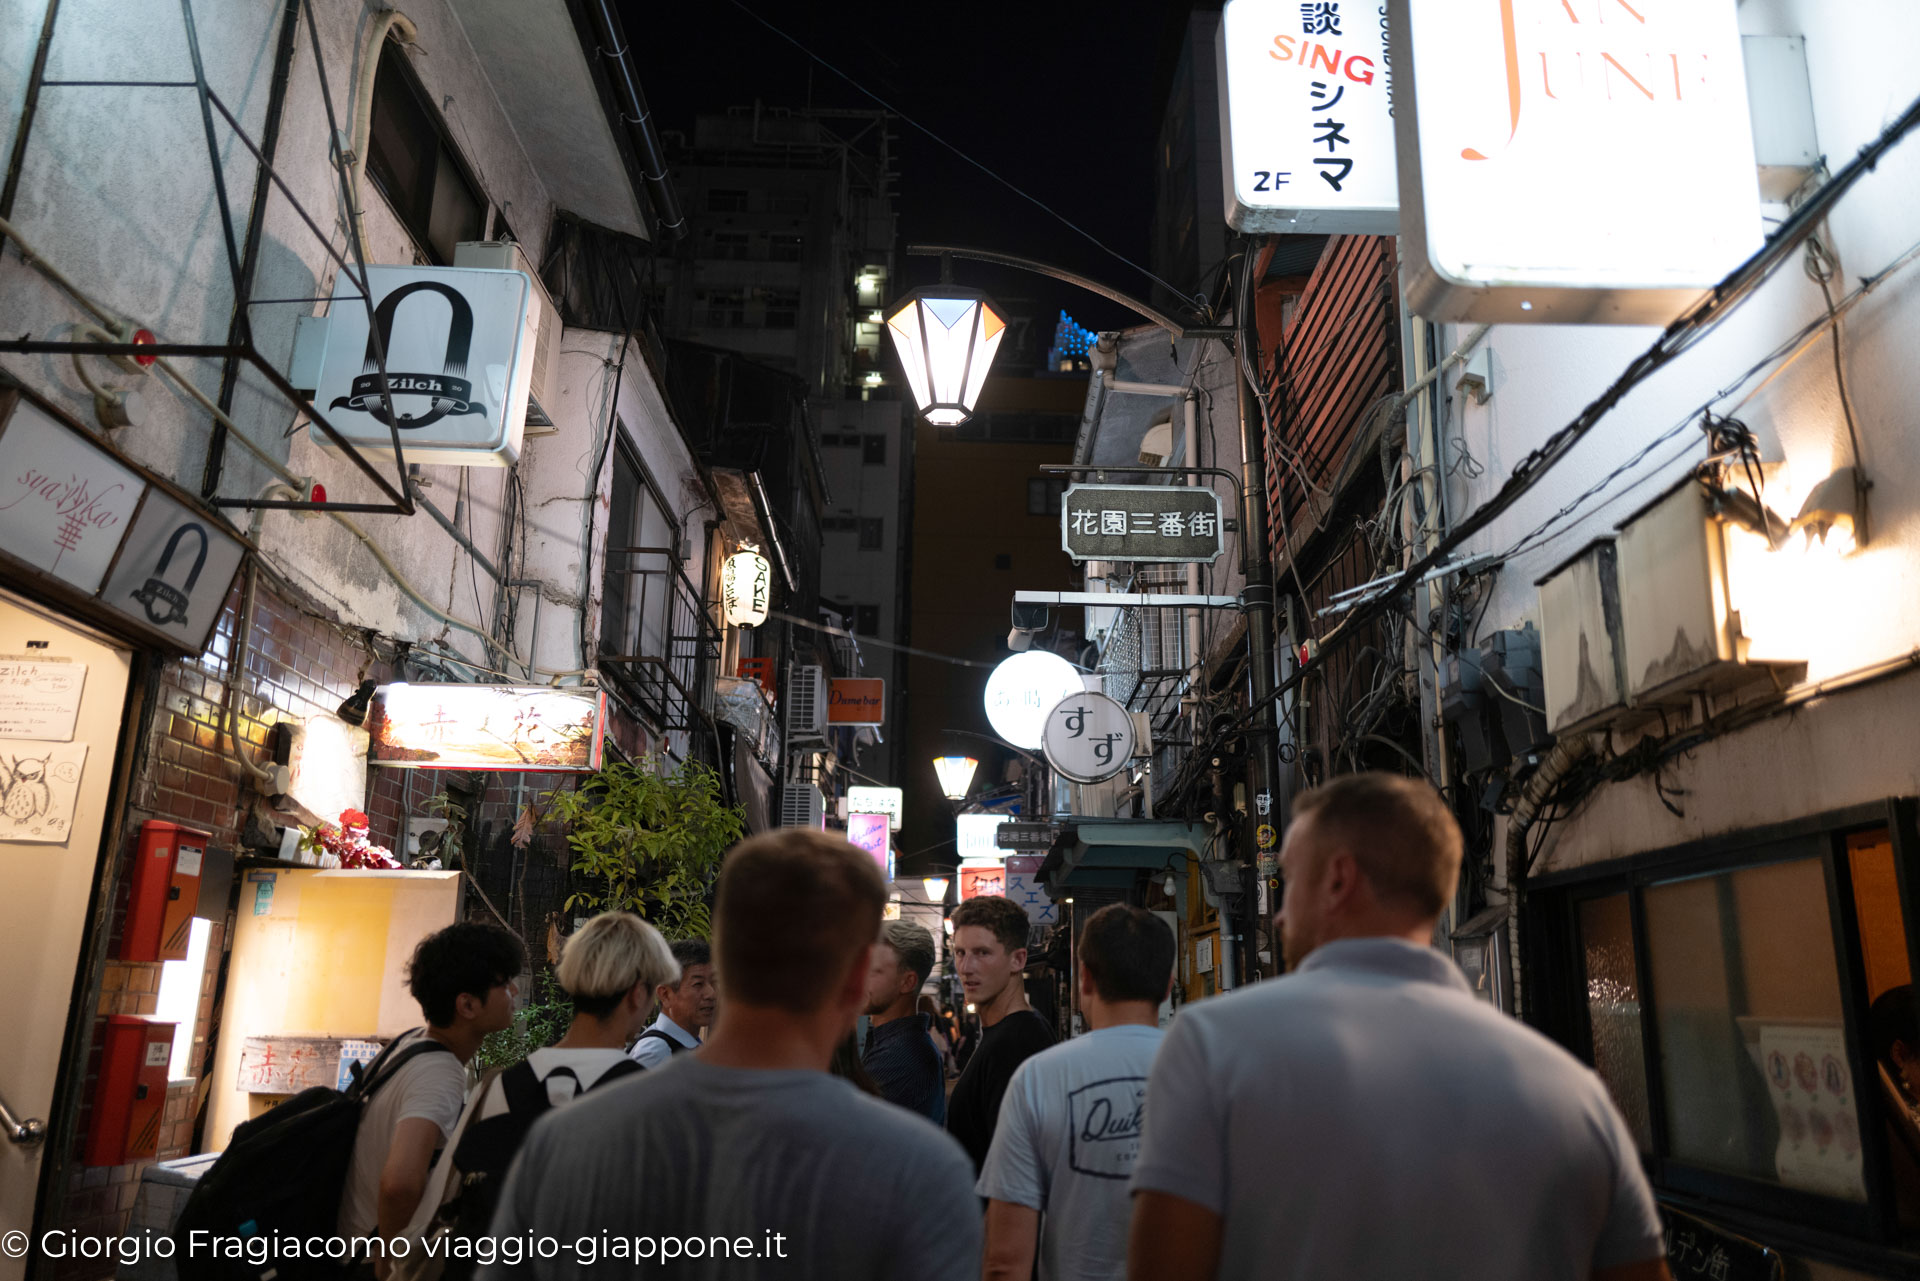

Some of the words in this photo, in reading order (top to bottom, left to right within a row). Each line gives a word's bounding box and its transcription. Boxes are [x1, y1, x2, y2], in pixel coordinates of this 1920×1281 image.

[1269, 34, 1375, 86] SING
[1310, 81, 1353, 191] シネマ
[1253, 171, 1291, 191] 2F
[387, 378, 443, 392] Zilch
[1071, 508, 1216, 538] 花園三番街
[752, 556, 768, 615] SAKE
[1059, 706, 1124, 767] すず
